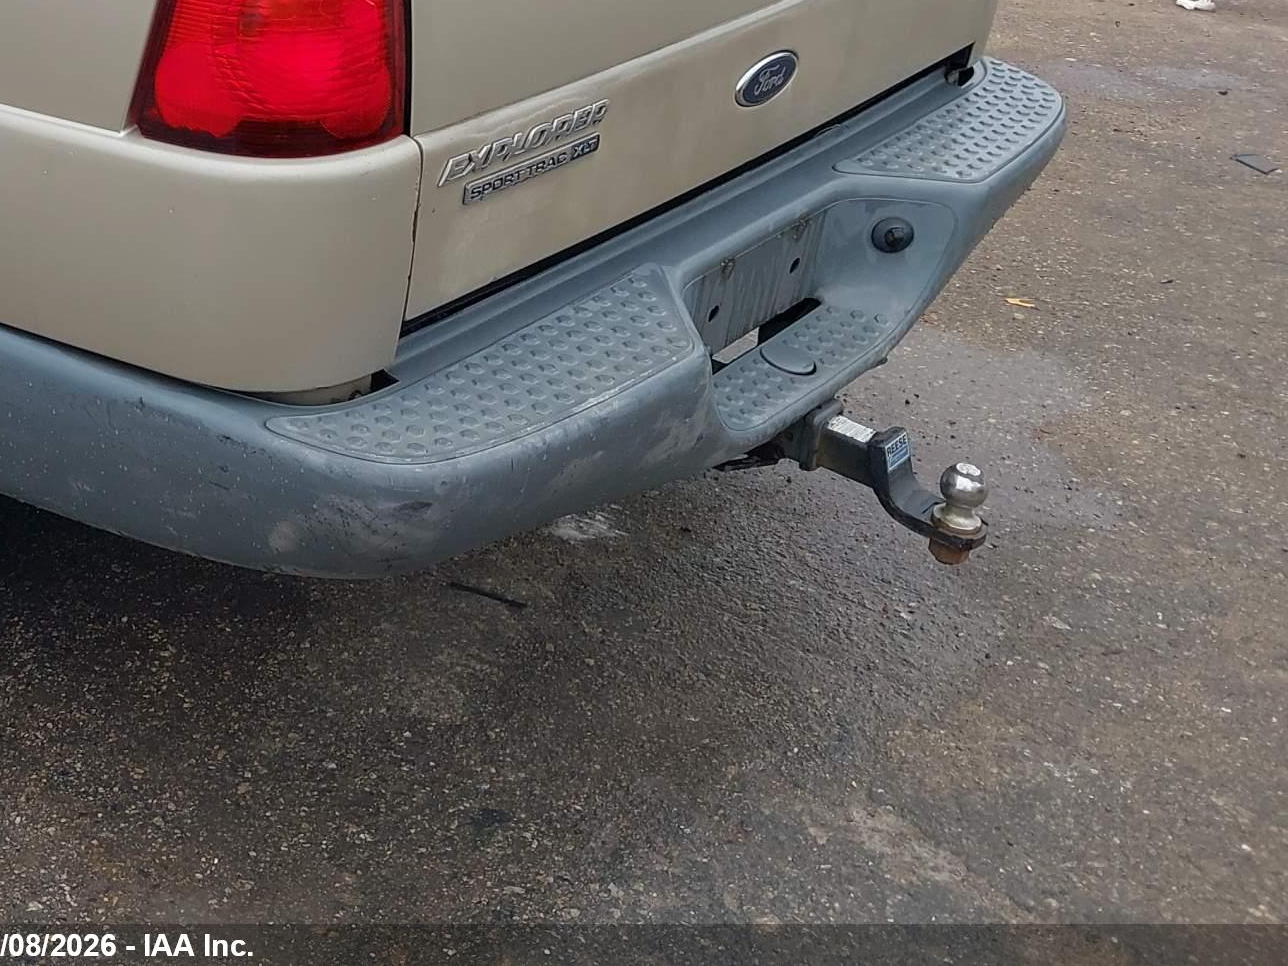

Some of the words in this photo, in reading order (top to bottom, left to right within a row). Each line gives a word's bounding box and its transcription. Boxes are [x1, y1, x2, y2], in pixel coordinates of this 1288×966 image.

[753, 64, 786, 96] Ford
[438, 98, 609, 187] EXPLORER
[470, 170, 522, 201] SPORT
[526, 151, 567, 178] TRAC
[573, 137, 599, 160] XLT
[886, 434, 908, 458] REESE
